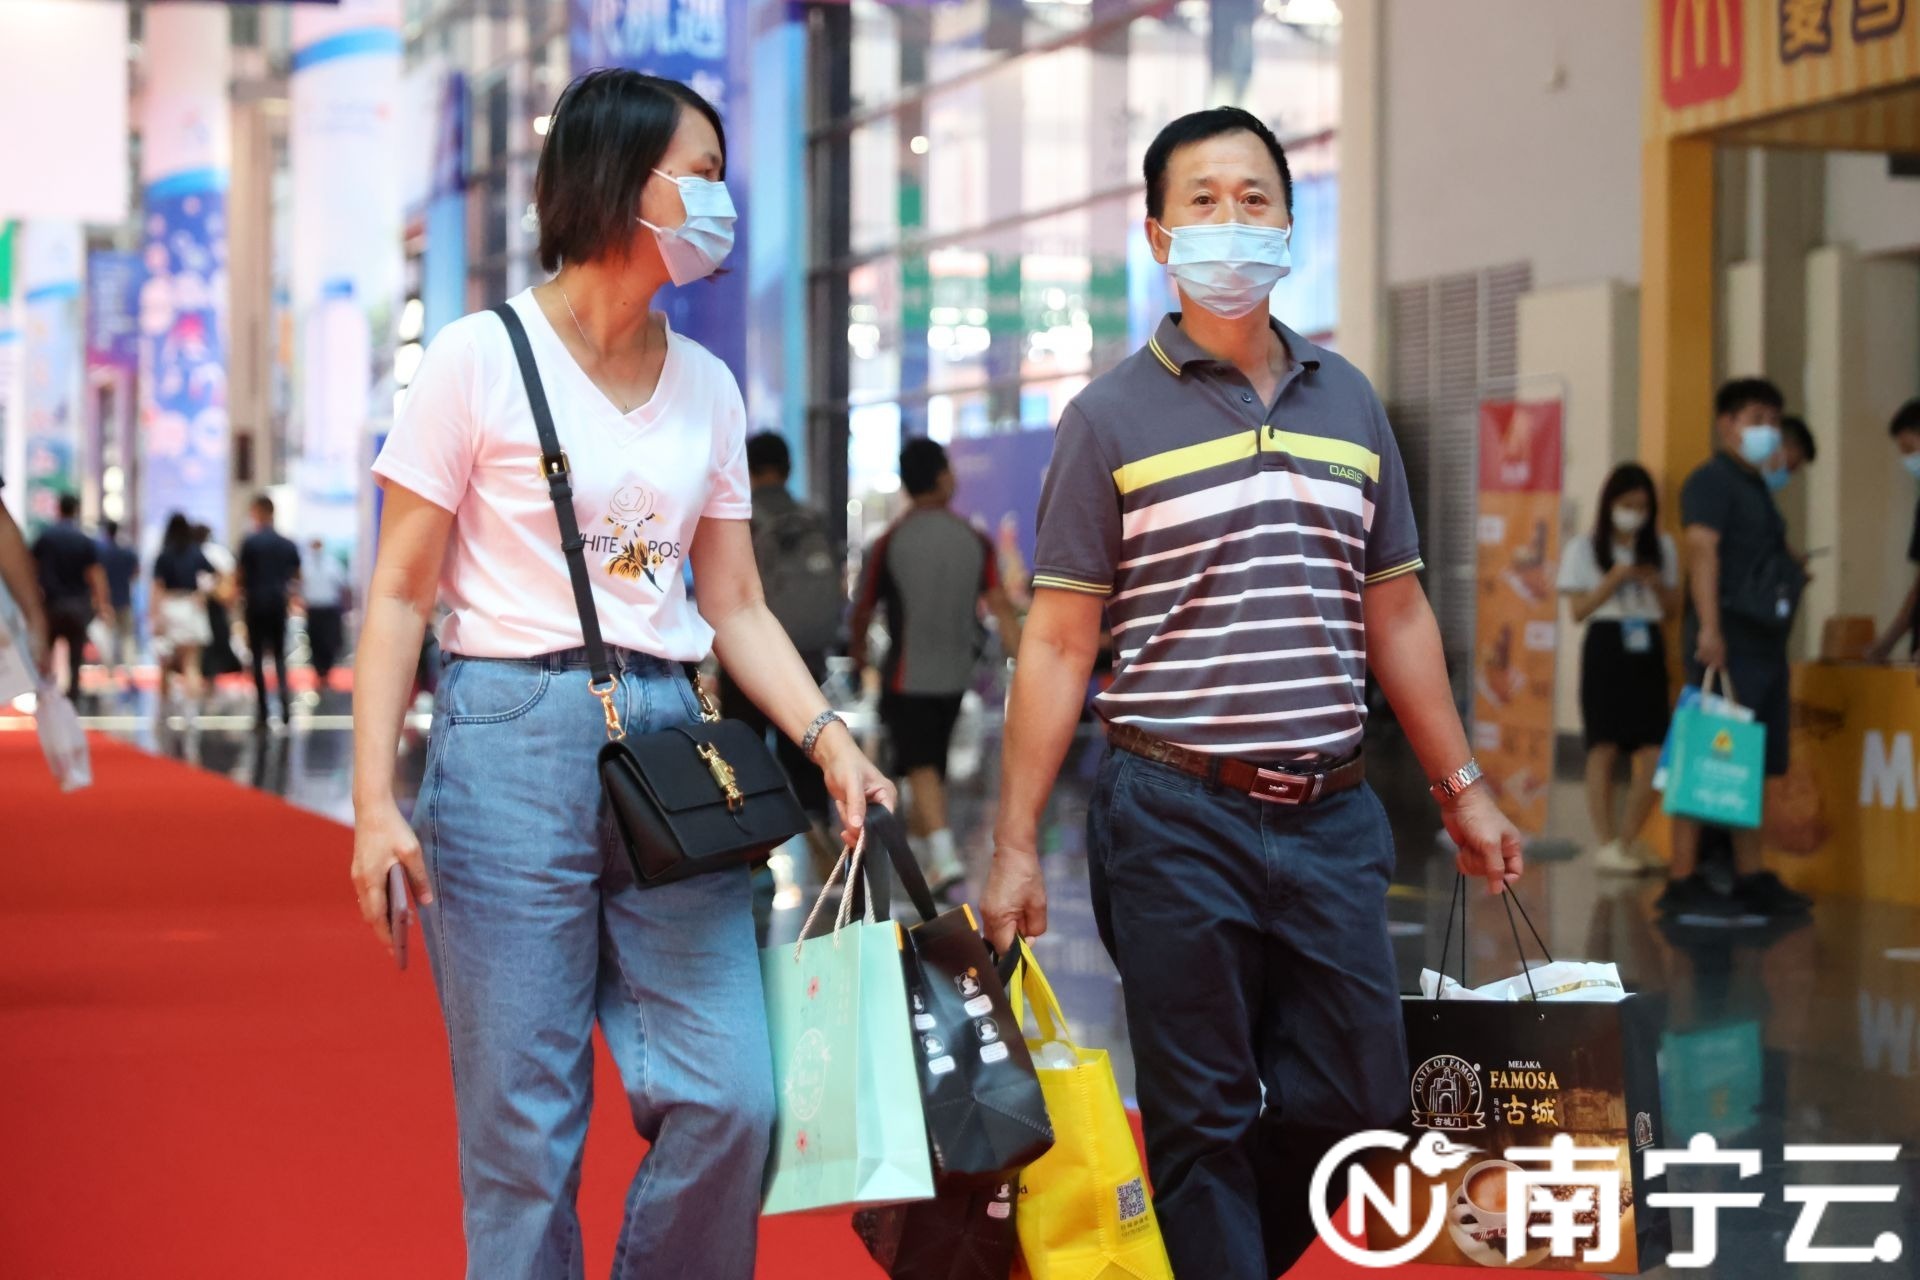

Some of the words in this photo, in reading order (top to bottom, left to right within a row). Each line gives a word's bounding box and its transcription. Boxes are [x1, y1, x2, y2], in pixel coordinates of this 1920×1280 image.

[1329, 464, 1363, 484] OASIS
[578, 532, 619, 554] HITE
[1859, 729, 1920, 813] M
[1508, 1060, 1541, 1069] MELAKA
[1414, 1064, 1432, 1092] GATE
[1433, 1058, 1447, 1068] OF
[1449, 1058, 1478, 1095] FAMOSA
[1489, 1071, 1559, 1090] FAMOSA
[1502, 1094, 1559, 1127] 古城
